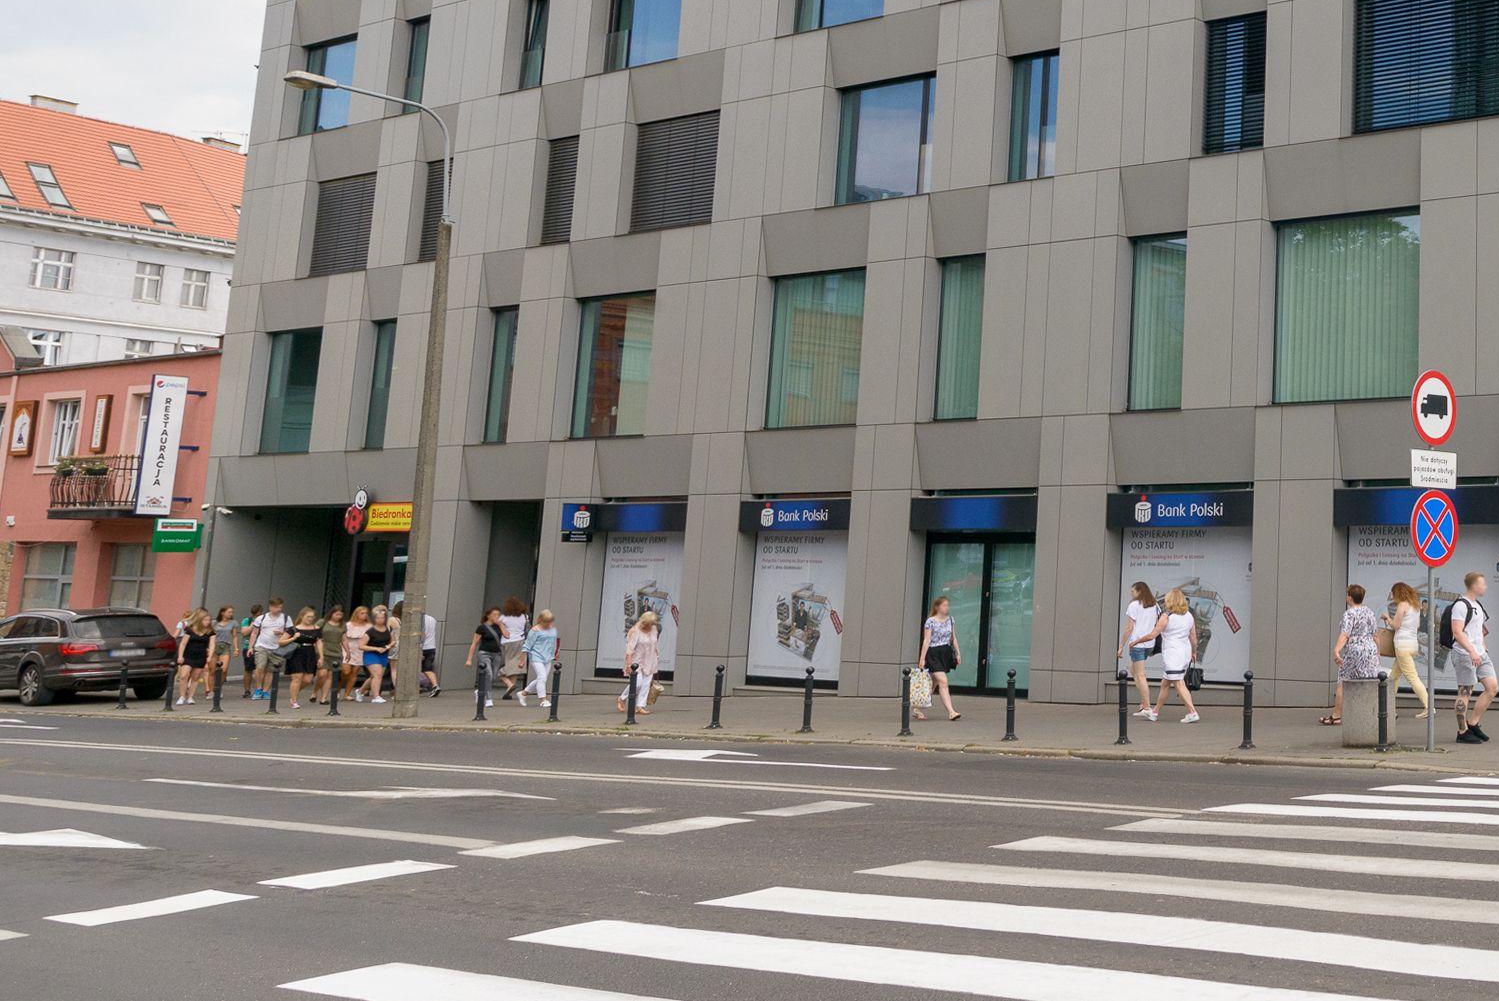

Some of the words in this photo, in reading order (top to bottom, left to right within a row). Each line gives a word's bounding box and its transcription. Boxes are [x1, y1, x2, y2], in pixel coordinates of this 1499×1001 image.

[152, 397, 173, 486] RESTAURACJA
[1157, 503, 1186, 517] Bank
[1190, 502, 1224, 517] Polski
[777, 509, 801, 522] Bank
[802, 508, 829, 521] Polski
[1131, 529, 1181, 539] WSPIERAMY
[1181, 529, 1207, 539] FIRMY
[1358, 526, 1411, 536] WSPIERAM
[1130, 541, 1143, 550] OD
[1145, 541, 1175, 550] STARTU
[1358, 538, 1373, 548] OD
[1375, 538, 1409, 548] STARTU
[622, 546, 644, 554] STARTU
[763, 545, 774, 554] OD
[774, 545, 799, 554] STARTU
